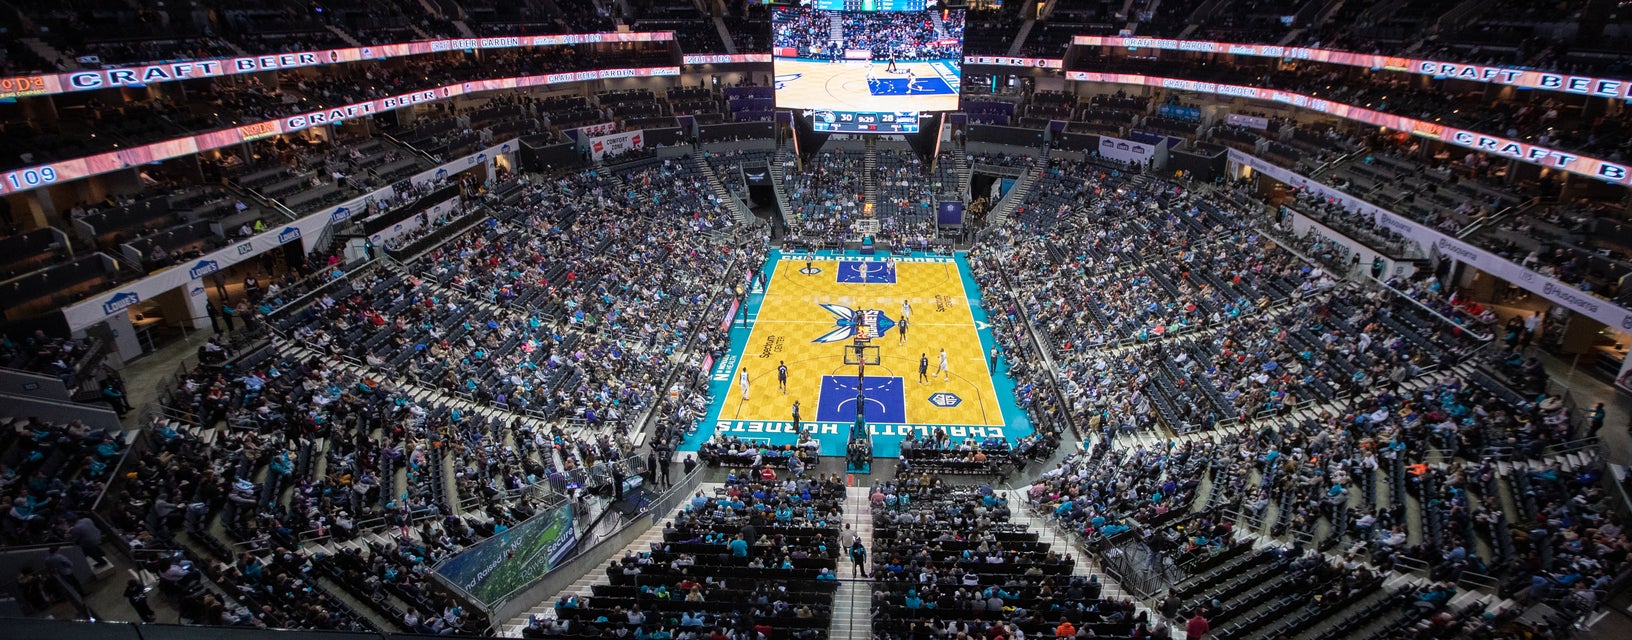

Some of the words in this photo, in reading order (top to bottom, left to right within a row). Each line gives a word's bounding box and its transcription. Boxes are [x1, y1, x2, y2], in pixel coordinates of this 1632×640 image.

[452, 39, 477, 49] BEER
[481, 38, 518, 48] GARDEN
[1123, 38, 1154, 47] CRAFT
[1156, 40, 1176, 49] BEER
[1179, 41, 1214, 51] GARDEN
[71, 60, 218, 88] CRAFT
[235, 52, 317, 72] BEER
[599, 69, 635, 78] GARDEN
[1419, 61, 1522, 84] CRAFT
[1217, 85, 1256, 97] GARDEN
[287, 102, 374, 129] CRAFT
[383, 90, 436, 109] BEER
[840, 113, 852, 121] 30
[882, 114, 894, 122] 28
[1454, 131, 1577, 168] CRAFT
[8, 165, 57, 189] 109
[279, 229, 301, 243] LOWE'S
[239, 244, 251, 254] 104
[191, 261, 218, 279] LOWE'S
[104, 294, 138, 314] LOWE'S
[1552, 287, 1600, 314] Husqvarna
[864, 424, 1006, 438] CHALOTT
[477, 555, 502, 582] Raised
